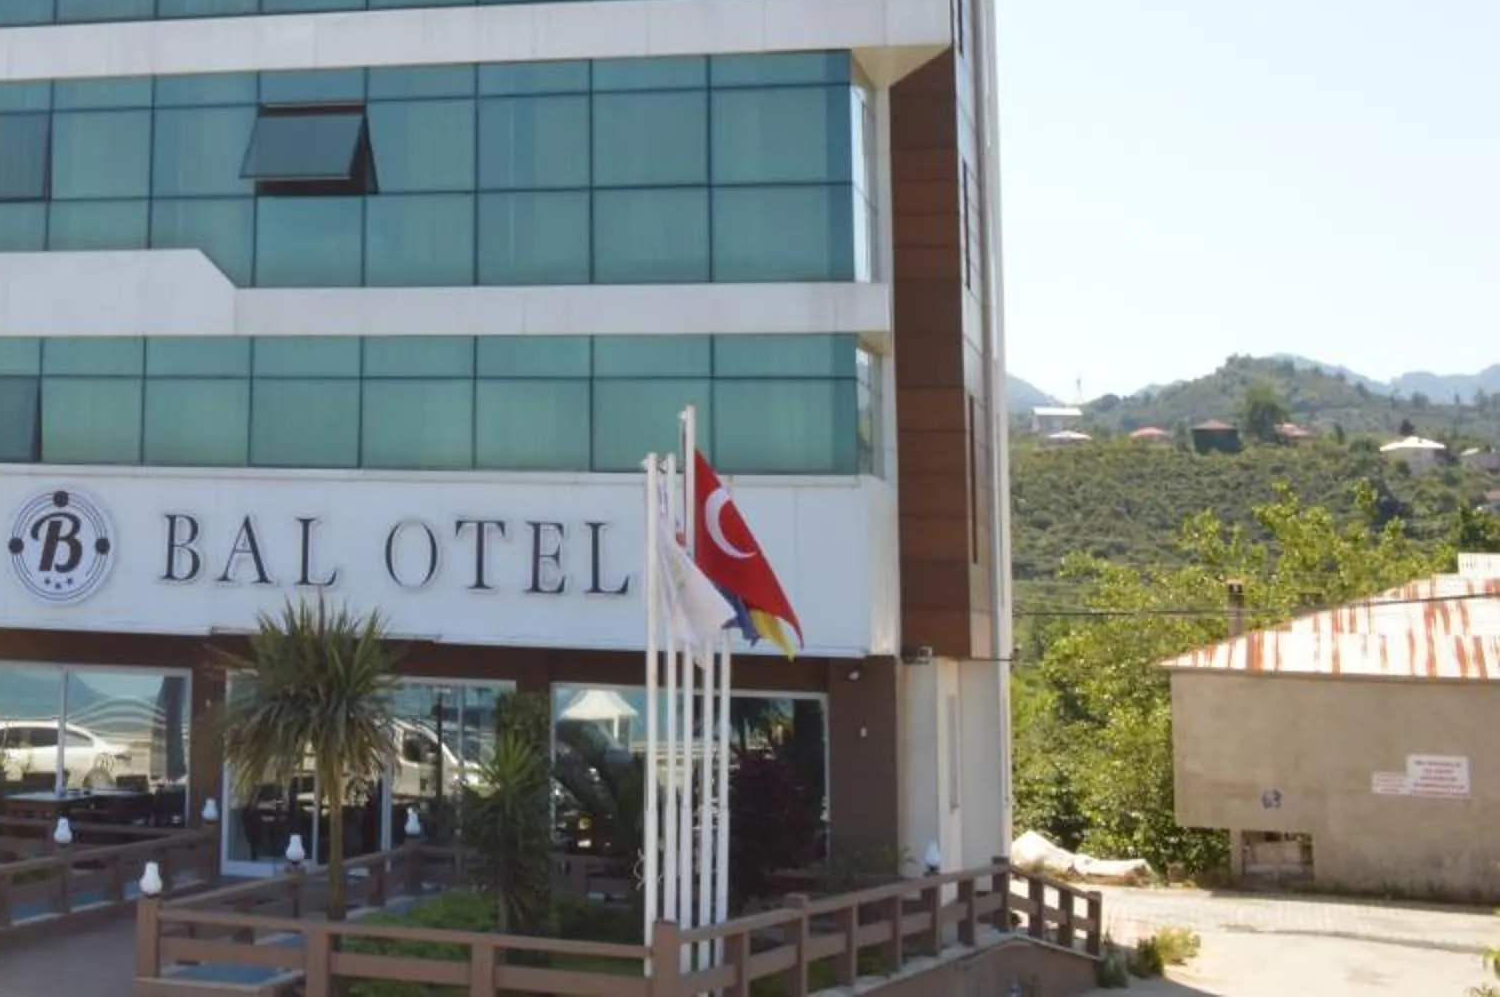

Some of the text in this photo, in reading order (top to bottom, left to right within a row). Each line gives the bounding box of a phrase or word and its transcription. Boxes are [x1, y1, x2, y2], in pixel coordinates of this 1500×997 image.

[30, 511, 83, 574] B
[159, 512, 632, 596] BAL OTEL
